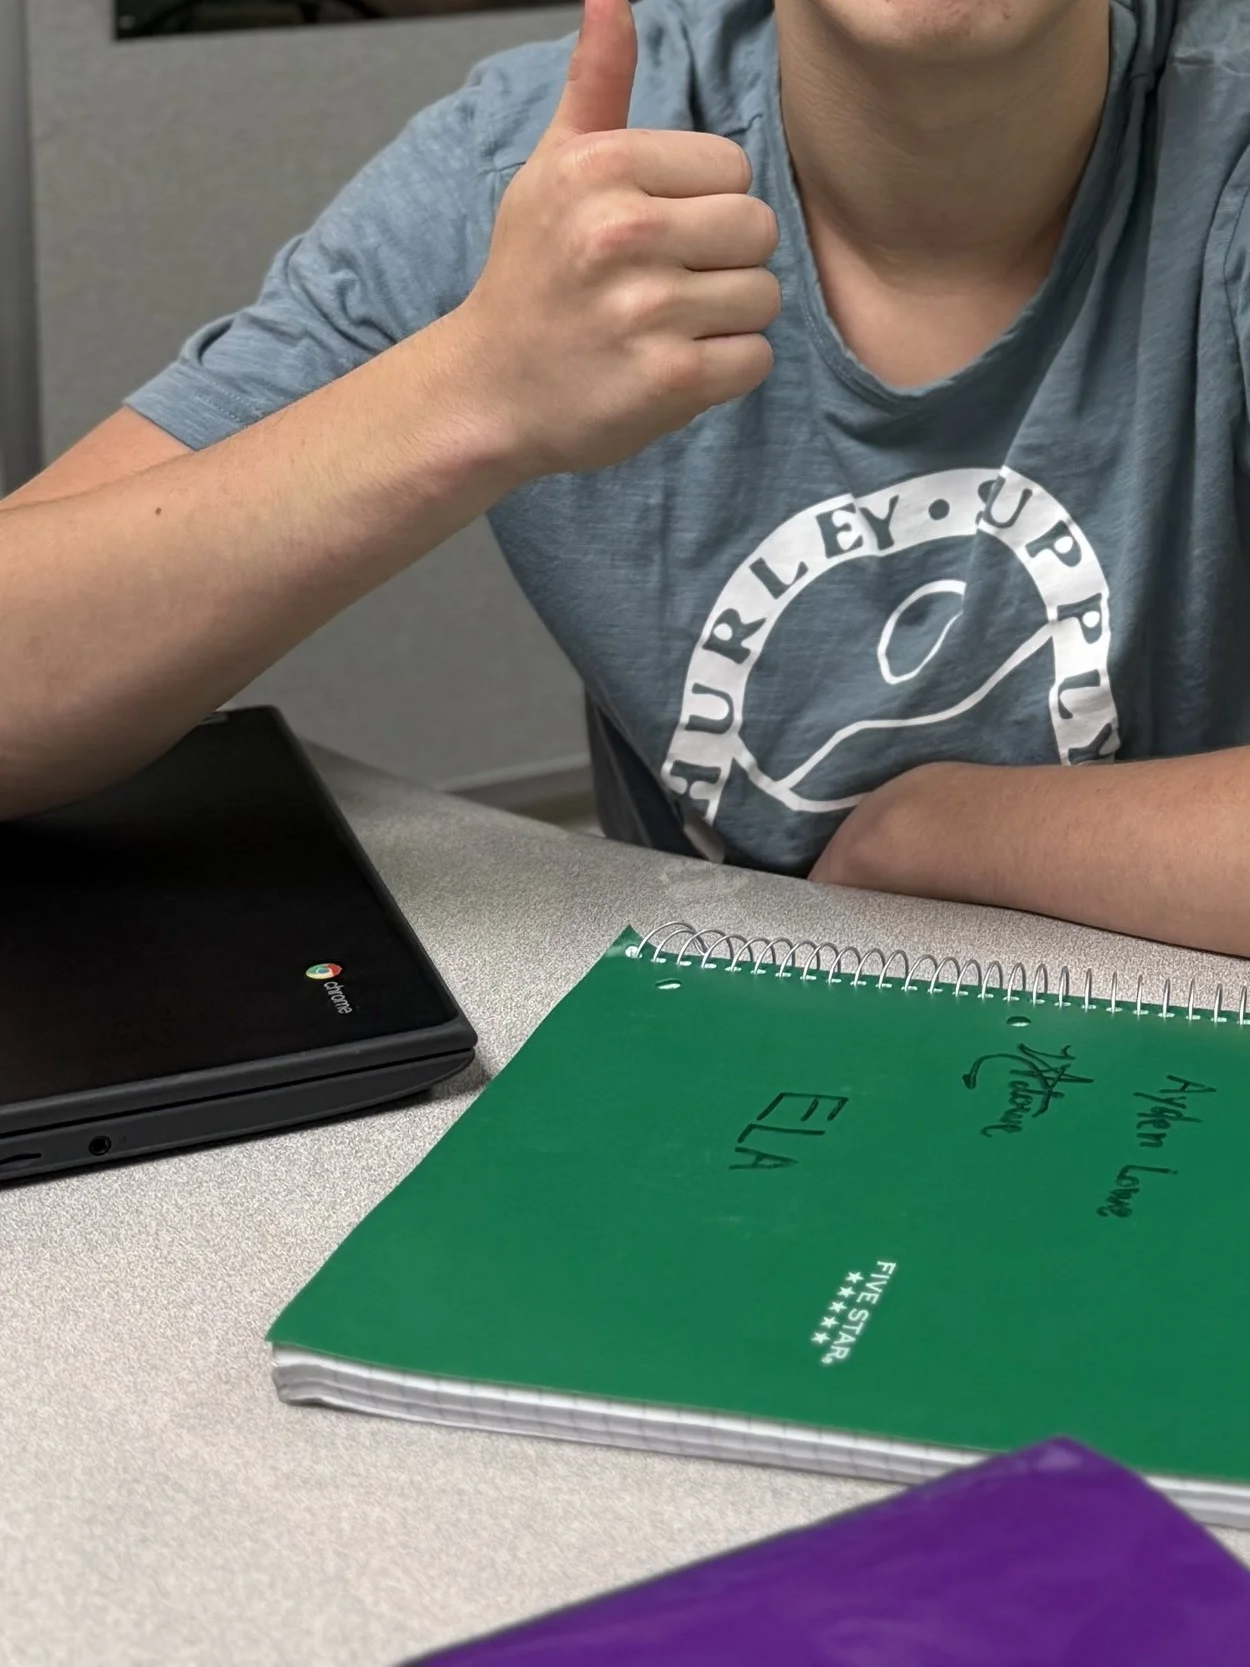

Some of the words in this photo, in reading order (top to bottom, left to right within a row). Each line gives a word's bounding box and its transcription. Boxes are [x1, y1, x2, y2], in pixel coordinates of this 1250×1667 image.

[670, 494, 899, 824] HURLEY
[323, 980, 353, 1014] chrome
[729, 1092, 849, 1170] ELA
[1133, 1074, 1218, 1148] Ayden
[855, 1260, 897, 1305] FIVE
[830, 1307, 870, 1361] STAR
